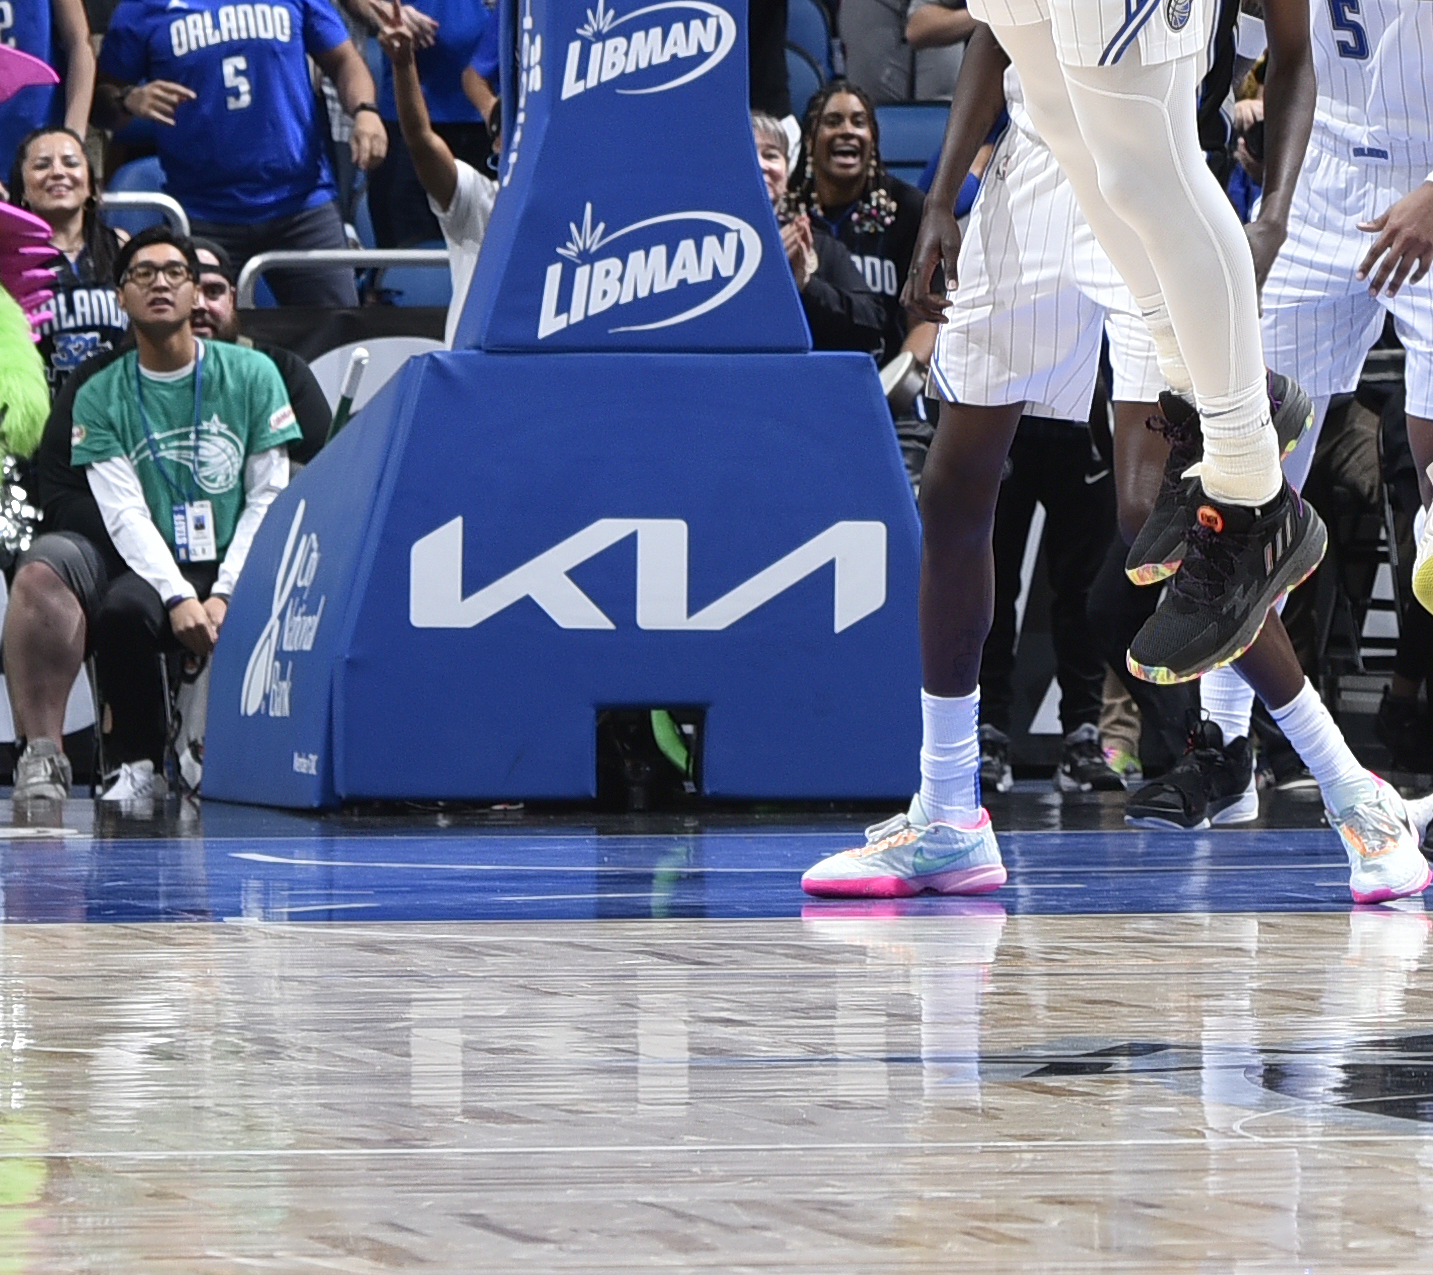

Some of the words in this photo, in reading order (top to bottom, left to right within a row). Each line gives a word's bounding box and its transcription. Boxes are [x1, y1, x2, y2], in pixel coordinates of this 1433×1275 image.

[169, 2, 291, 57] ORLANDO
[561, 15, 719, 100] LIBMAN
[221, 54, 252, 112] 5
[538, 231, 739, 339] LIBMAN
